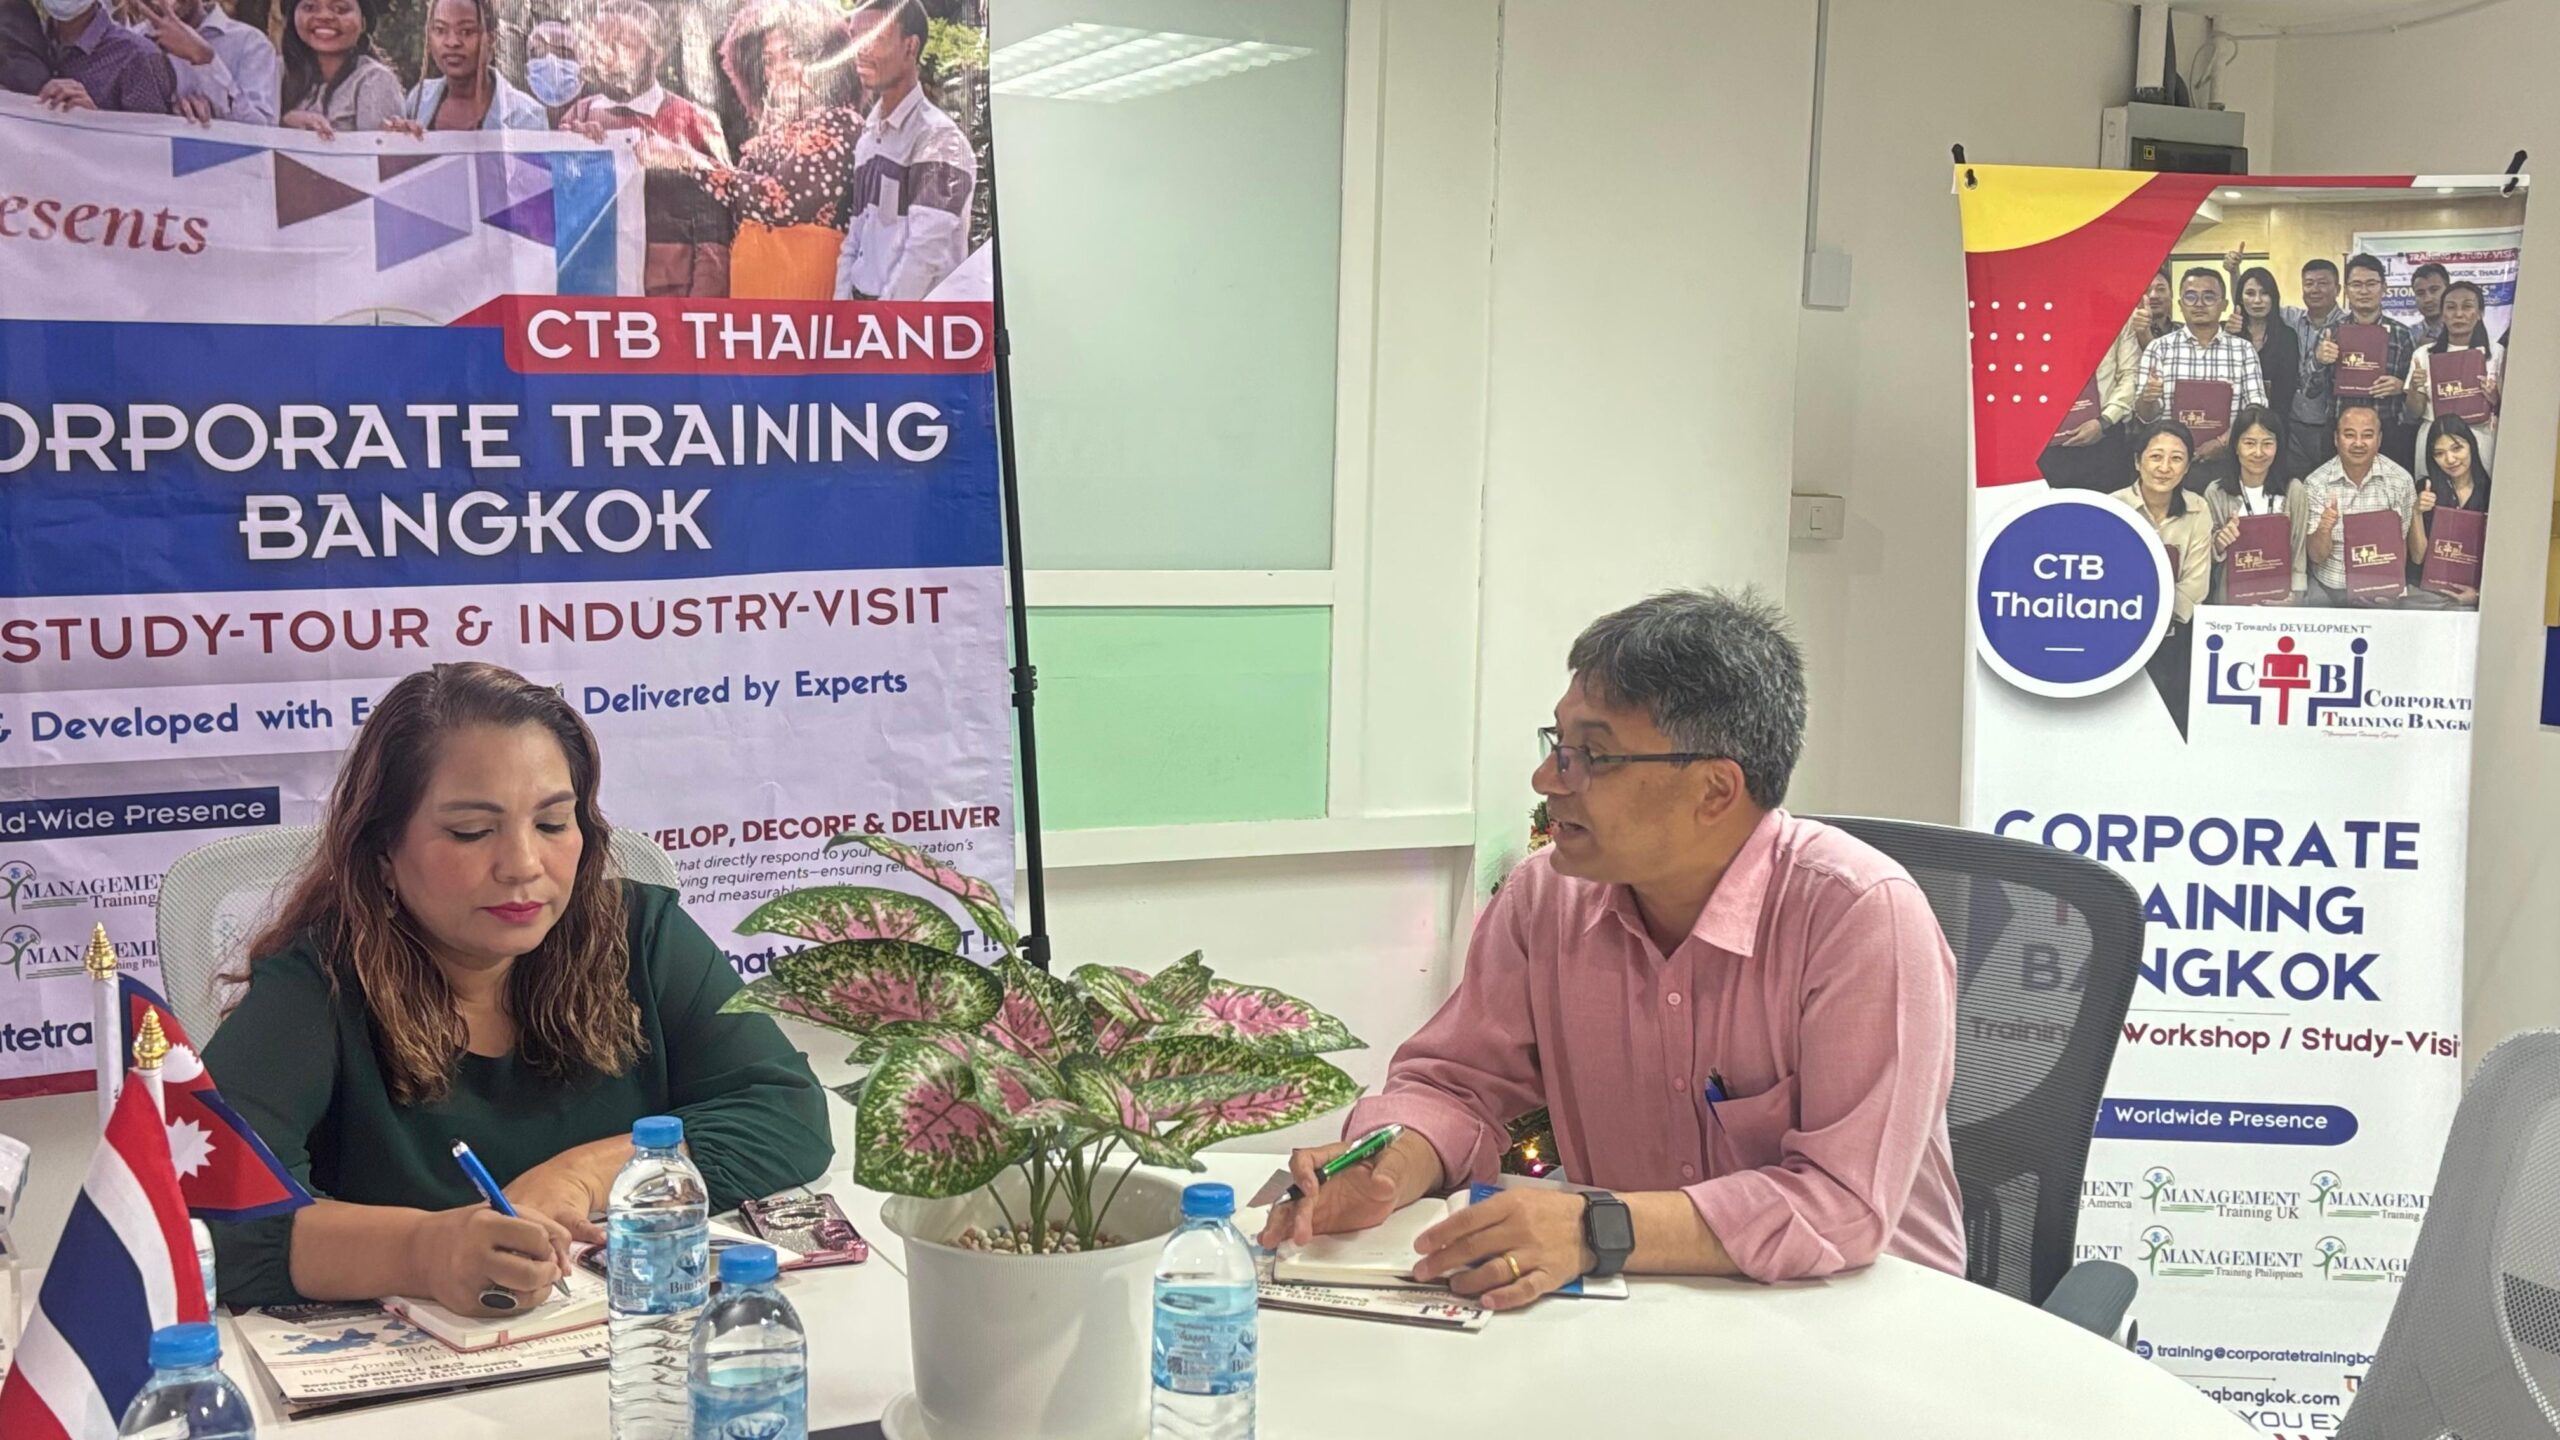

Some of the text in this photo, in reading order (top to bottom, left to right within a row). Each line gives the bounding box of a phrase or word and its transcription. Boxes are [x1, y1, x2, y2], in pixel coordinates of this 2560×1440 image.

[526, 309, 985, 362] CTB THAILAND
[551, 401, 950, 464] TRAINING
[240, 487, 712, 562] BANGKOK
[1991, 553, 2142, 620] CTB Thailand
[2, 585, 950, 663] STUDY-TOUR & INDUSTRY-VISIT
[2235, 622, 2277, 632] Towards
[584, 670, 908, 714] Delivered by Experts
[32, 702, 239, 744] Developed
[256, 697, 333, 732] with
[2322, 711, 2403, 728] TRAINING
[124, 799, 267, 826] Presence
[643, 823, 736, 852] VELOP,
[863, 813, 886, 835] &
[892, 806, 1000, 833] DELIVER
[1994, 809, 2420, 870] CORPORATE
[675, 859, 701, 872] that
[704, 853, 758, 868] directly
[760, 848, 820, 864] respond
[822, 849, 838, 860] to
[842, 849, 876, 863] your
[23, 873, 167, 900] MANAGEME
[687, 884, 801, 905] and measurabl
[90, 893, 157, 909] Training
[2141, 882, 2365, 935] AINING
[723, 946, 776, 975] hat
[0, 1020, 93, 1052] tetra
[2122, 1022, 2460, 1059] Workshop / Study-Visi
[2114, 1106, 2222, 1126] Worldwide
[2229, 1110, 2328, 1130] Presence
[2087, 1198, 2132, 1210] America
[2161, 1188, 2301, 1207] MANAGEMENT
[2329, 1191, 2432, 1209] MANAGEM
[2216, 1205, 2300, 1222] Training UK
[2381, 1209, 2420, 1222] Training
[2160, 1248, 2303, 1269] MANAGEMENT
[2334, 1256, 2407, 1272] MANAG
[2215, 1266, 2303, 1280] Training Philippines
[2157, 1344, 2375, 1367] training@corporatetrainingb
